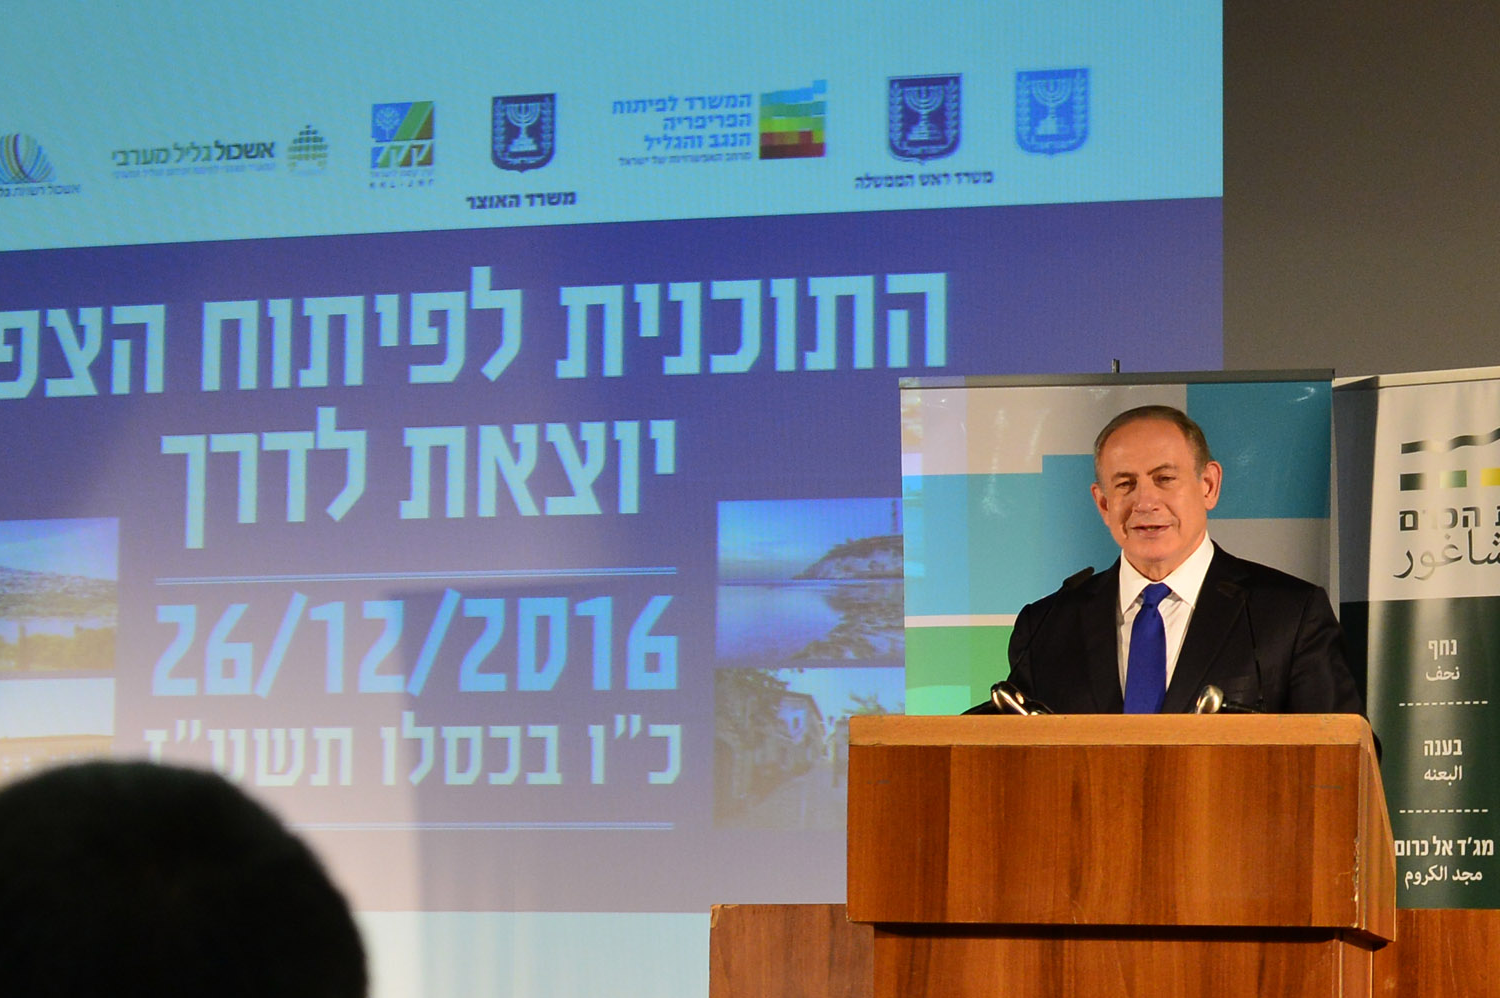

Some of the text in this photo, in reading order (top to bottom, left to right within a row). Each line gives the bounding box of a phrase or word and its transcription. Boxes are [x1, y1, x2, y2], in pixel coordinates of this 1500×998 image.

[612, 93, 752, 114] המשרד לפיתוח
[663, 113, 752, 130] הפריפריה
[172, 141, 213, 163] גליל
[644, 133, 752, 151] הנגב והגליל
[111, 148, 170, 166] מערבי
[466, 191, 578, 210] משרד האוצר
[201, 265, 524, 392] לפיתוח
[556, 272, 949, 379] התוכנית
[160, 406, 678, 549] יוצאת לדרך
[1399, 506, 1481, 532] הכם
[152, 588, 680, 699] 26/12/2016
[1428, 639, 1458, 660] נחף
[1425, 665, 1460, 682] نحف
[380, 711, 563, 786] בכסלו
[1424, 738, 1463, 756] בענה
[1394, 839, 1429, 856] כרום
[1432, 835, 1453, 856] אל
[1404, 864, 1483, 890] مجد الكروم
